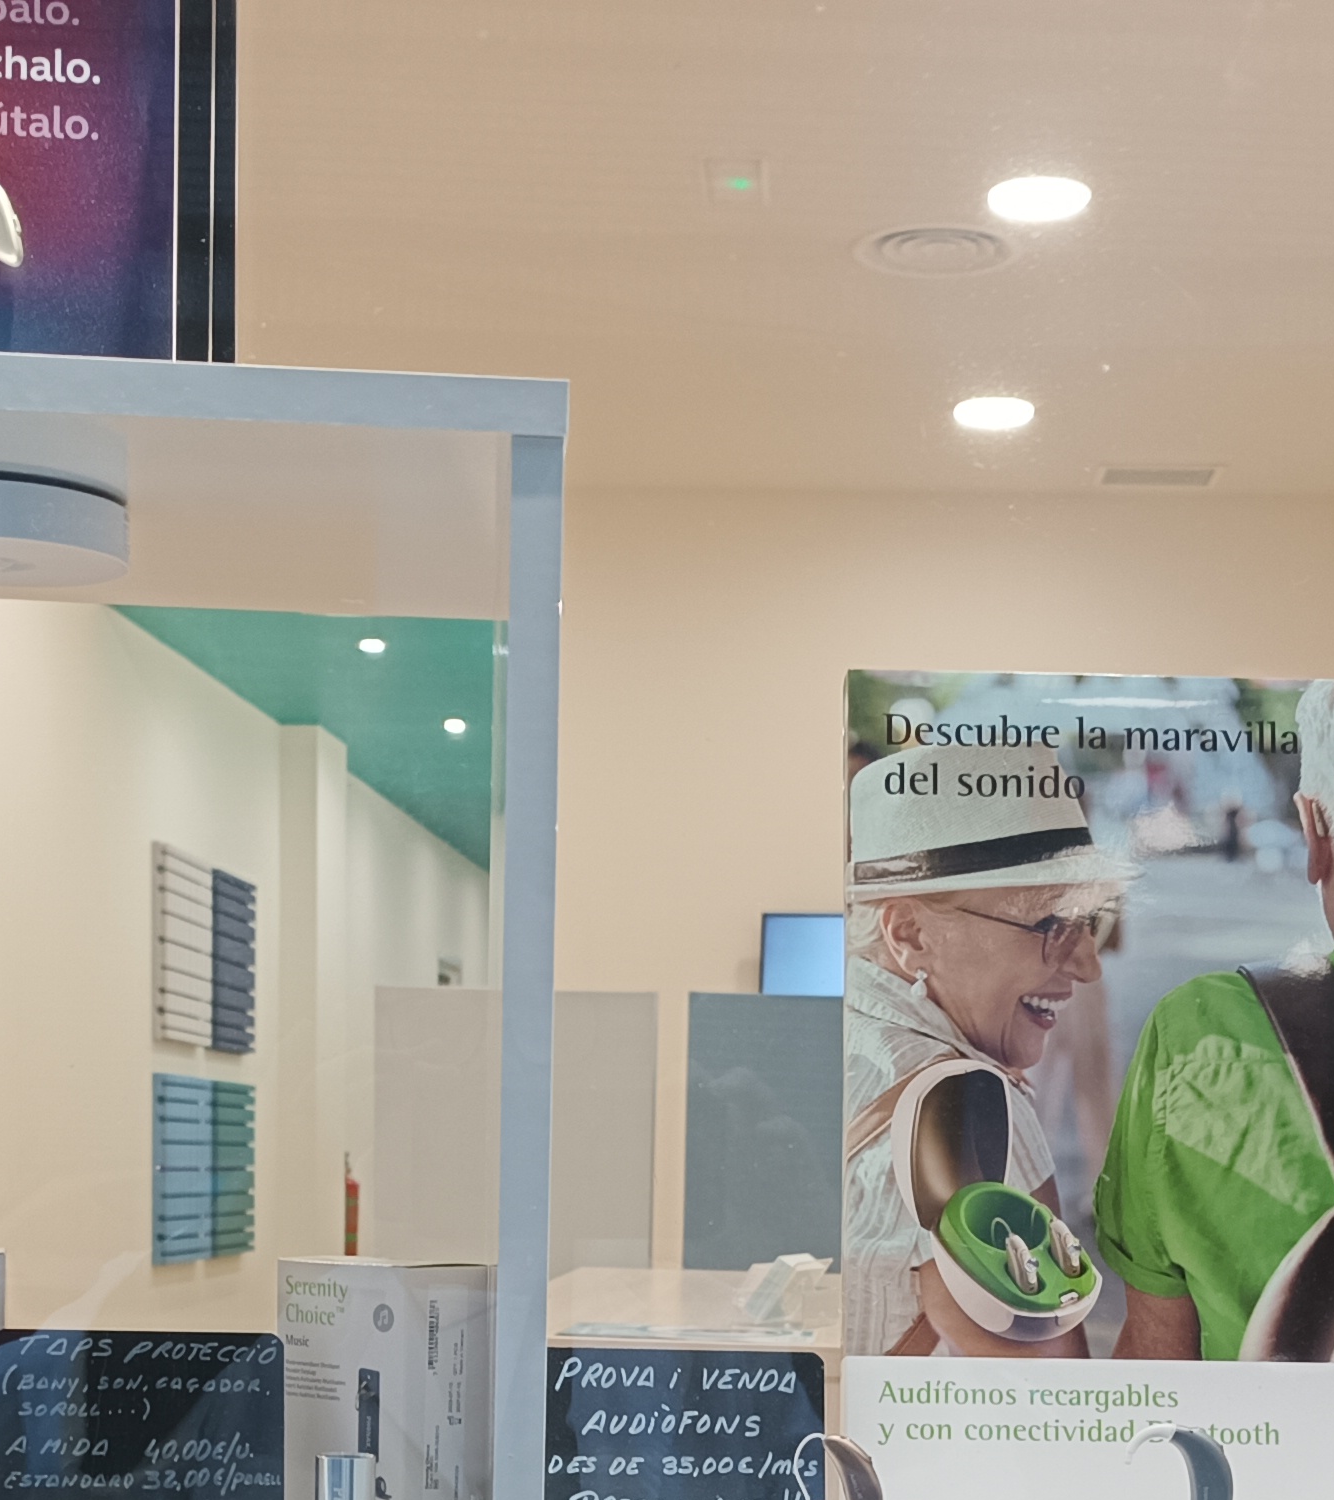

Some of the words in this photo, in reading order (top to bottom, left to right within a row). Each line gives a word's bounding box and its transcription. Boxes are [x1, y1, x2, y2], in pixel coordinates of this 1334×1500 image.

[883, 713, 1060, 748] Descubre
[1077, 717, 1108, 751] la
[1125, 721, 1299, 755] maravilla
[884, 761, 938, 797] del
[957, 765, 1086, 800] sonido
[285, 1274, 349, 1303] Serenity
[19, 1335, 113, 1361] TAPS
[285, 1333, 310, 1348] Music
[555, 1356, 655, 1391] PROVA
[702, 1367, 797, 1393] VENDA
[878, 1380, 1017, 1405] Audífonos
[1028, 1384, 1179, 1413] recargables
[5, 1435, 27, 1456] A
[878, 1422, 895, 1446] y
[906, 1422, 952, 1440] con
[964, 1419, 1135, 1443] conectividad
[1146, 1420, 1280, 1445] tooth
[548, 1455, 597, 1474] DES
[608, 1456, 645, 1475] DE
[4, 1471, 134, 1489] ESTANDARD
